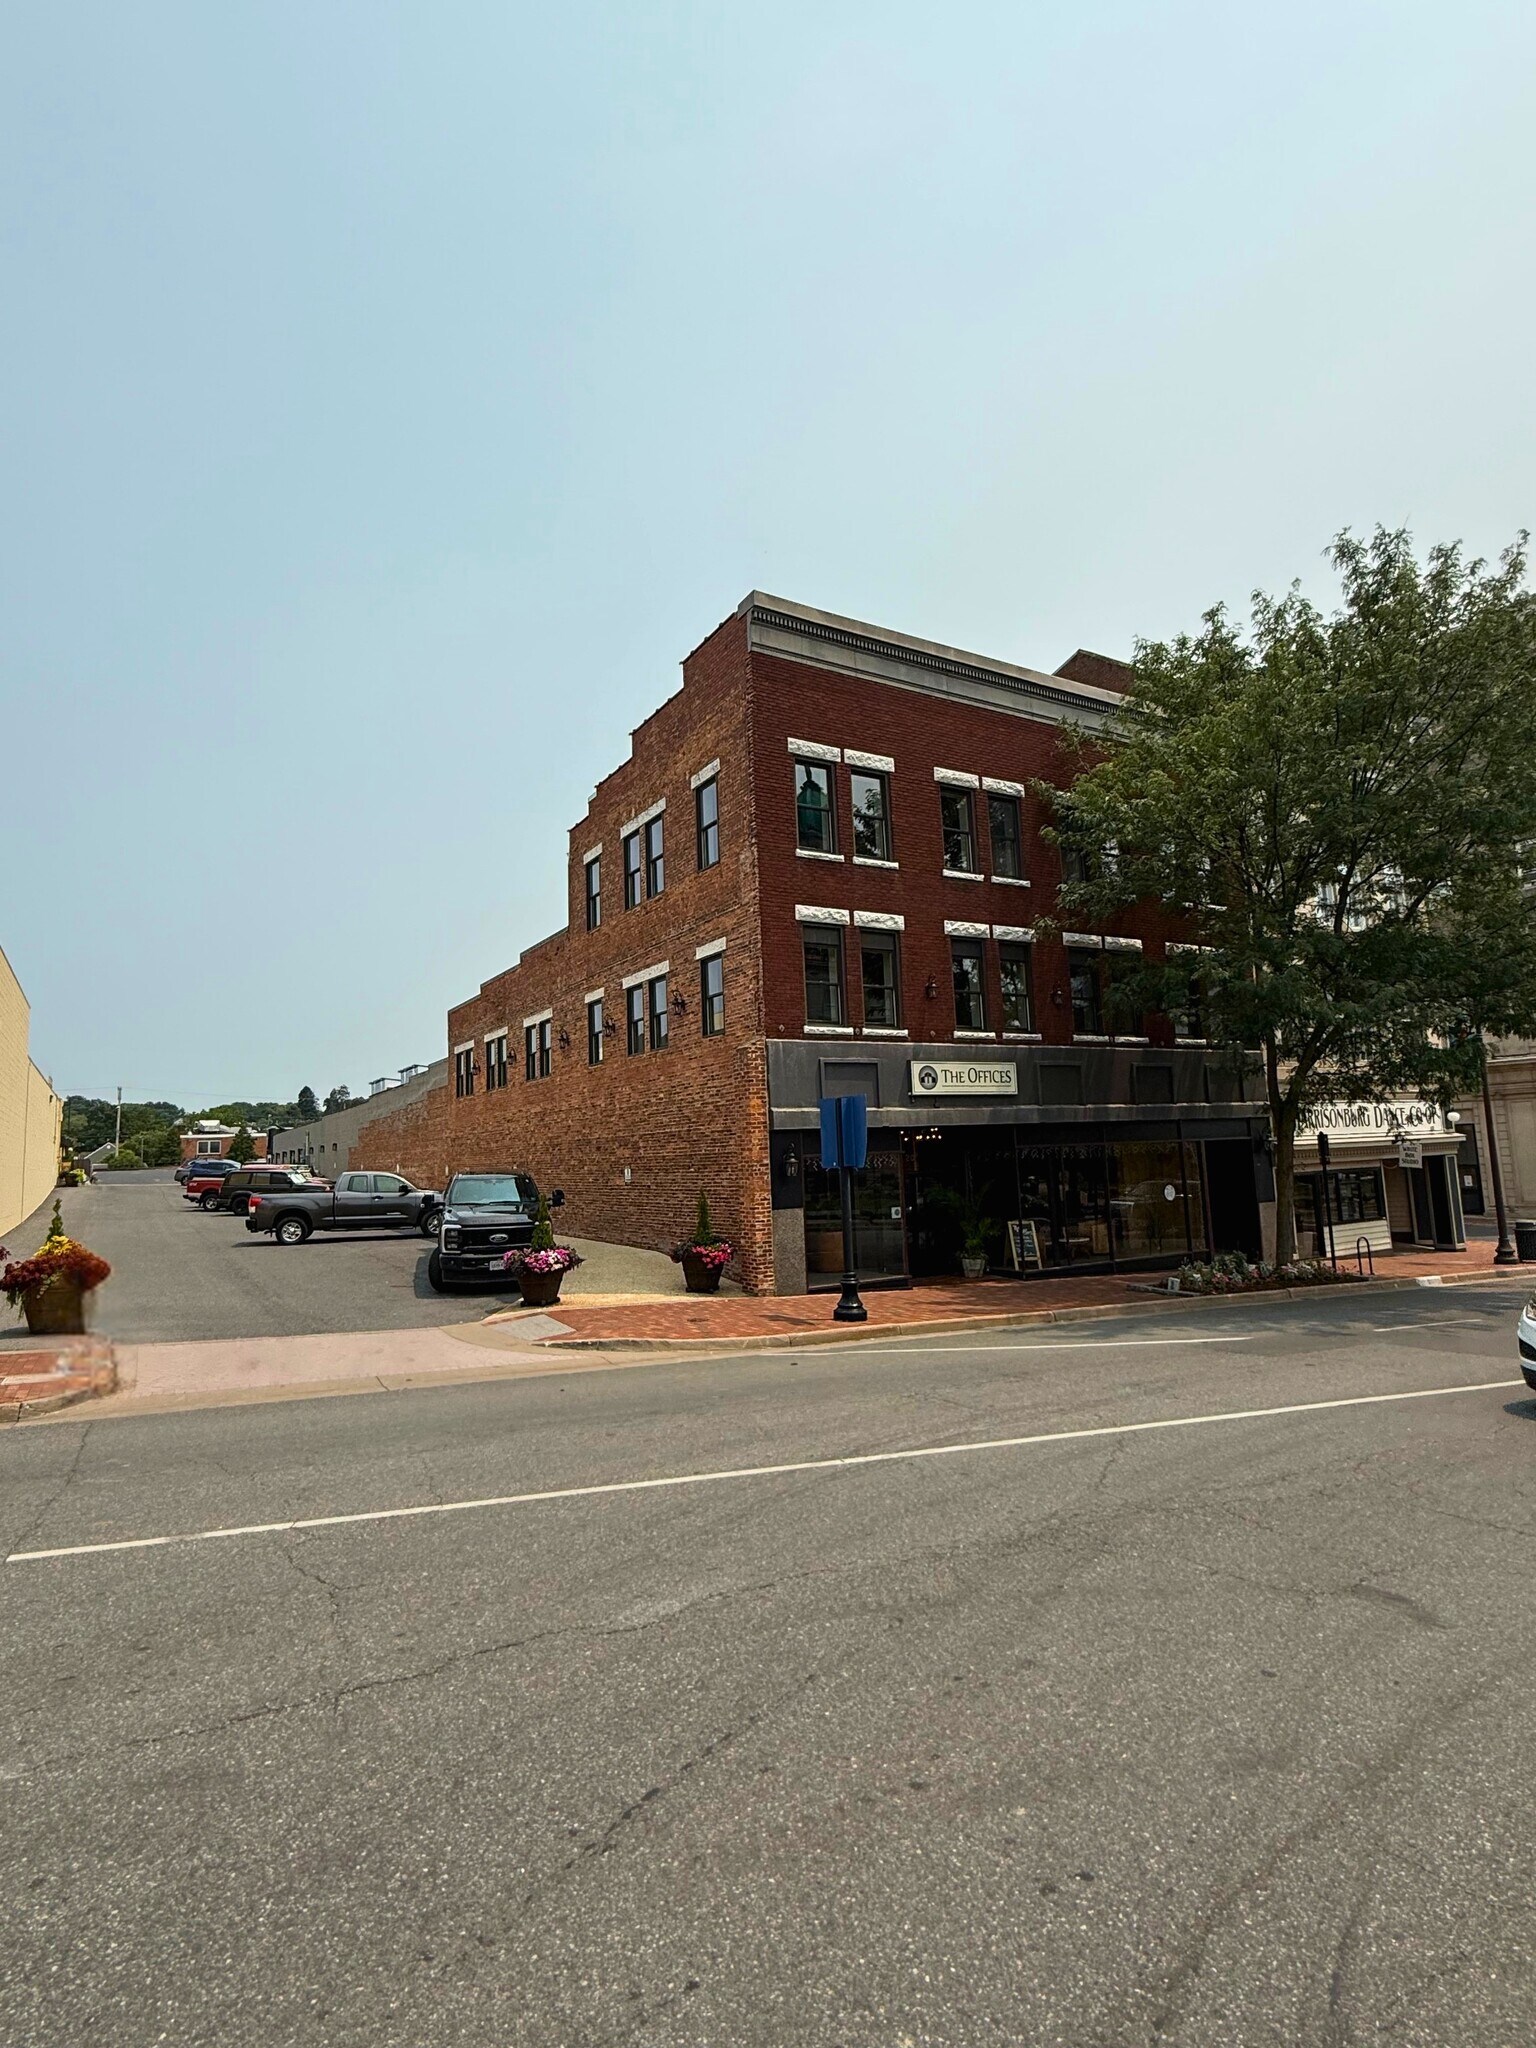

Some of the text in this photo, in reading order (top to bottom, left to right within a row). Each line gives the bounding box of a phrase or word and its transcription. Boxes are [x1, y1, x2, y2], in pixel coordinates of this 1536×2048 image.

[941, 1067, 1012, 1083] THE OFFICES
[1298, 1107, 1371, 1129] ARRISONBURG
